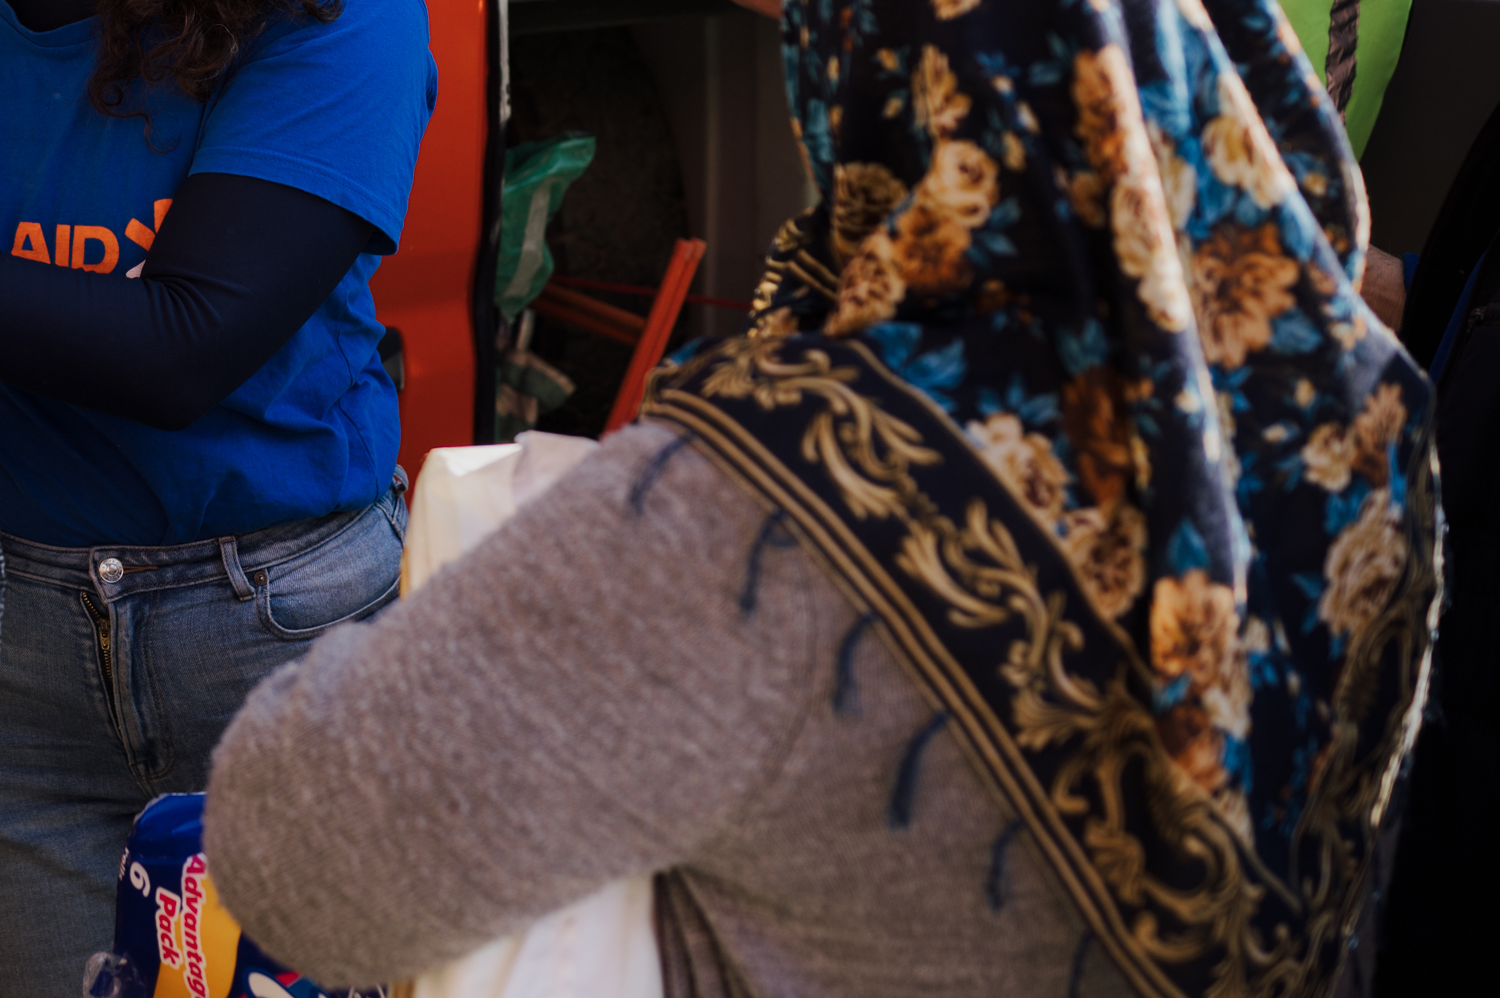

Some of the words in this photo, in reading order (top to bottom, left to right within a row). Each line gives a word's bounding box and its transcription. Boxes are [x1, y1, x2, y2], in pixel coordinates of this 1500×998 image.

[129, 861, 151, 898] 6
[157, 889, 182, 967] Pack
[182, 852, 208, 998] Advantag
